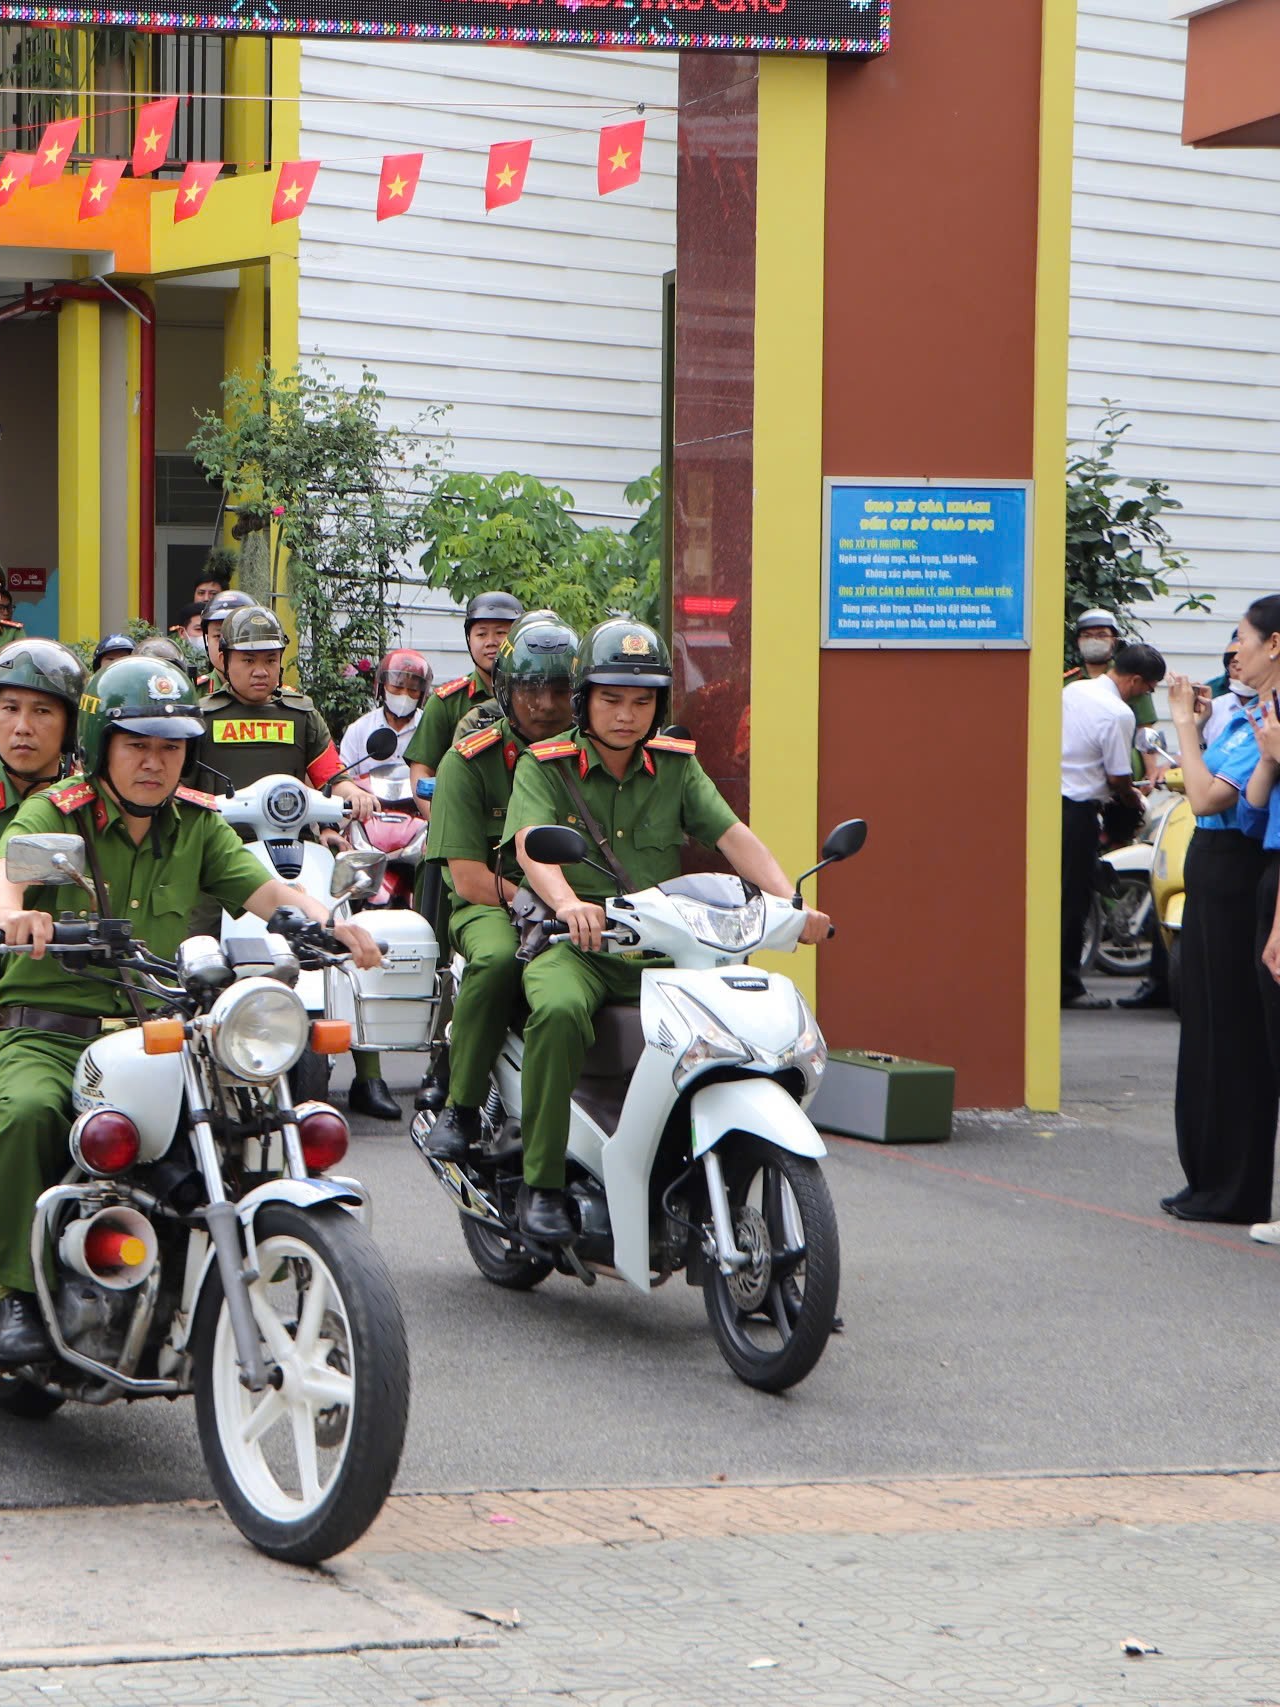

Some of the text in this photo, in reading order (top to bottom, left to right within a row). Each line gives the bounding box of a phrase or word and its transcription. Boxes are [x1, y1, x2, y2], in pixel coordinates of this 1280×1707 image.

[222, 721, 288, 741] ANTT
[733, 980, 767, 988] HONDA
[648, 1039, 675, 1058] HONDA
